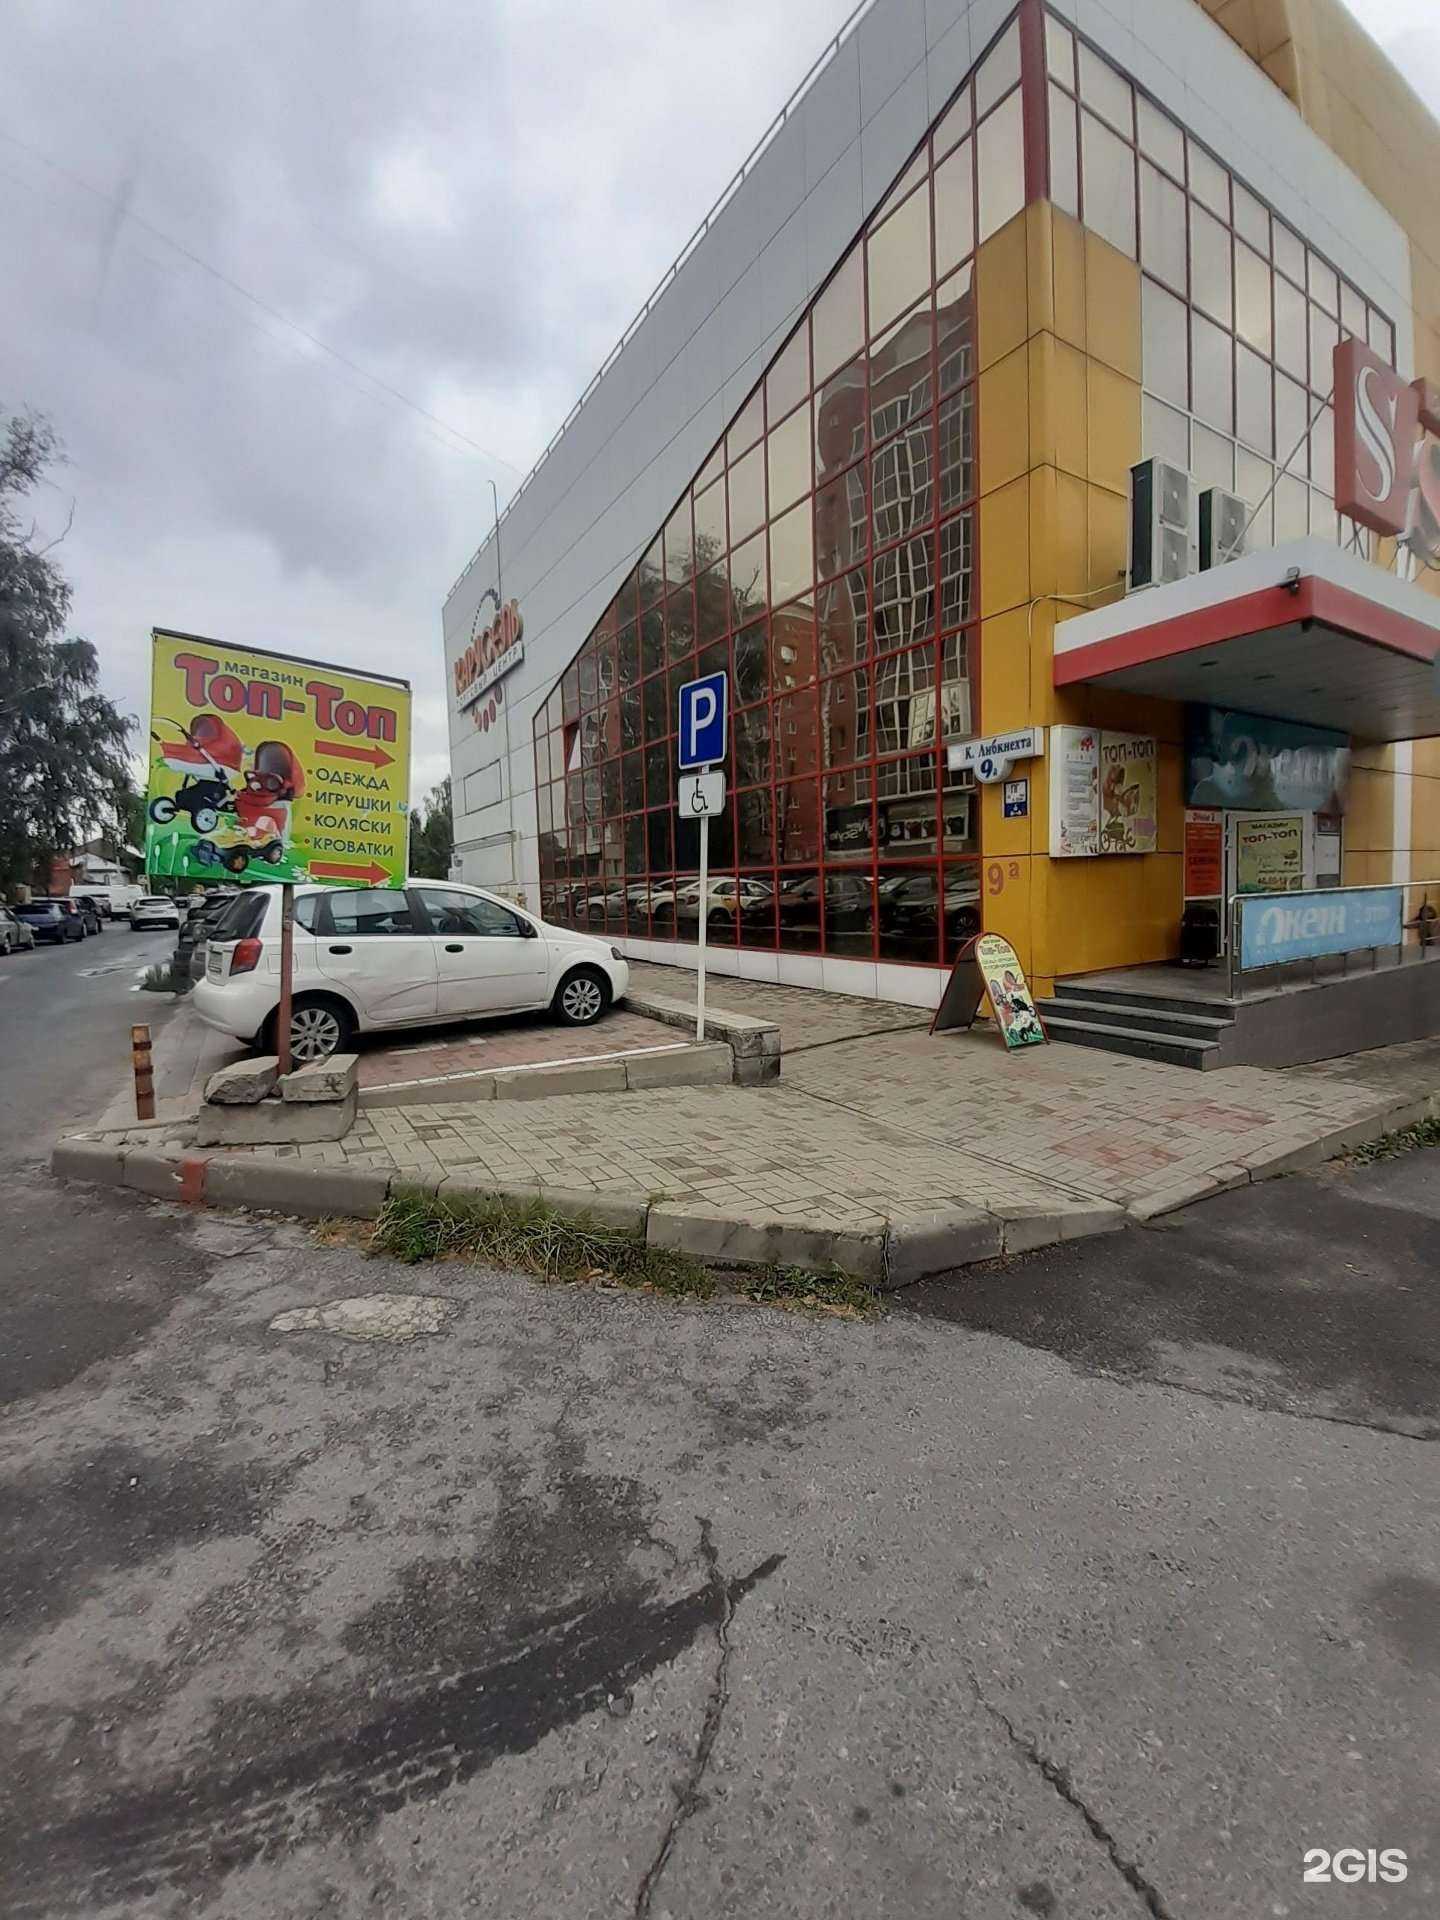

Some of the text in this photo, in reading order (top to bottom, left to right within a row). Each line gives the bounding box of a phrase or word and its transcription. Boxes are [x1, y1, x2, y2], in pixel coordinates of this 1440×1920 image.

[224, 661, 304, 688] магазин
[690, 687, 717, 758] P
[964, 736, 1032, 760] К. Либкнехта
[315, 767, 390, 791] ОДЕЖДА
[315, 791, 391, 813] ИГРУШКИ
[314, 813, 391, 835] КОЛЯСКИ
[313, 837, 394, 857] КРОВАТКИ
